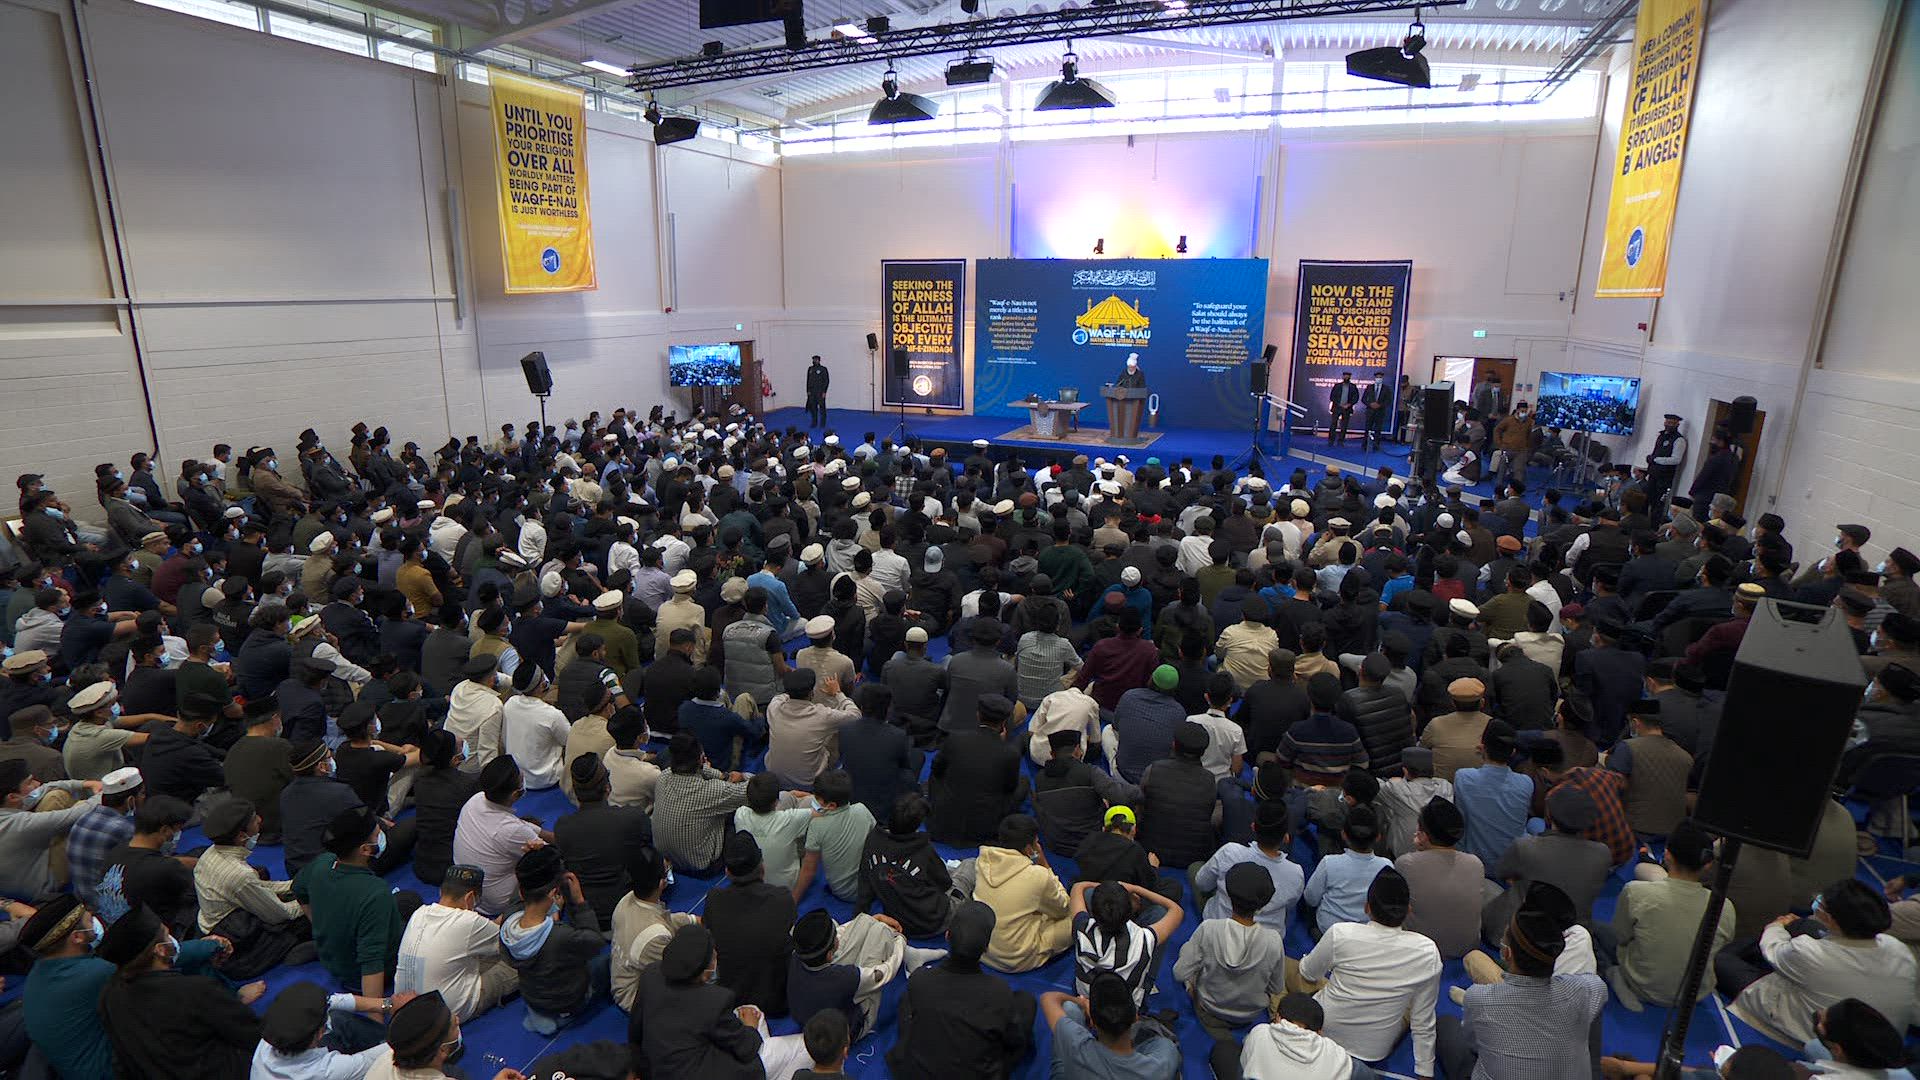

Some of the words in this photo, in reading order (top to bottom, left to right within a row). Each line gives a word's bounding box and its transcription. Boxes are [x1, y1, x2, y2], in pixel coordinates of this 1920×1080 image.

[1683, 26, 1694, 41] THE
[1635, 41, 1692, 89] RMEMBRANCE
[1649, 62, 1691, 108] ALLAH
[505, 104, 543, 125] UNTIL
[547, 113, 572, 131] YOU
[1636, 102, 1671, 128] MEMBERS
[506, 122, 573, 146] PRIORITISE
[1626, 112, 1683, 152] SRROUNDED
[508, 138, 533, 152] YOUR
[536, 144, 574, 158] RELIGION
[1622, 154, 1632, 176] B
[1634, 134, 1681, 171] ANGELS
[508, 151, 547, 170] OVER
[552, 158, 574, 174] ALL
[509, 168, 543, 180] WORLDLY
[510, 179, 538, 192] BEING
[542, 184, 562, 194] PART
[566, 186, 576, 195] OF
[510, 191, 577, 209] WAQF-E-NAU
[521, 206, 537, 215] JUST
[540, 208, 578, 218] WORTHLESS
[893, 280, 934, 290] SEEKING
[936, 280, 953, 290] THE
[1311, 285, 1348, 297] NOW
[1351, 286, 1364, 297] IS
[1368, 286, 1394, 298] THE
[893, 290, 953, 302] NEARNESS
[1311, 297, 1335, 306] TIME
[1338, 298, 1353, 307] TO
[1356, 298, 1392, 308] STAND
[893, 303, 910, 314] OF
[913, 303, 953, 314] ALLAH
[1310, 315, 1333, 326] THE
[1336, 315, 1390, 327] SACRED
[893, 323, 953, 334] OBJECTIVE
[1089, 329, 1151, 339] WAQF-E-NAU
[1309, 326, 1338, 334] VOW...
[1341, 327, 1390, 335] PRIORITISE
[893, 334, 915, 345] FOR
[918, 334, 953, 346] EVERY
[1308, 334, 1389, 351] SERVING
[1307, 349, 1330, 357] YOUR
[1332, 350, 1356, 358] FAITH
[1306, 356, 1363, 366] EVERYTHING
[1366, 359, 1387, 367] ELSE
